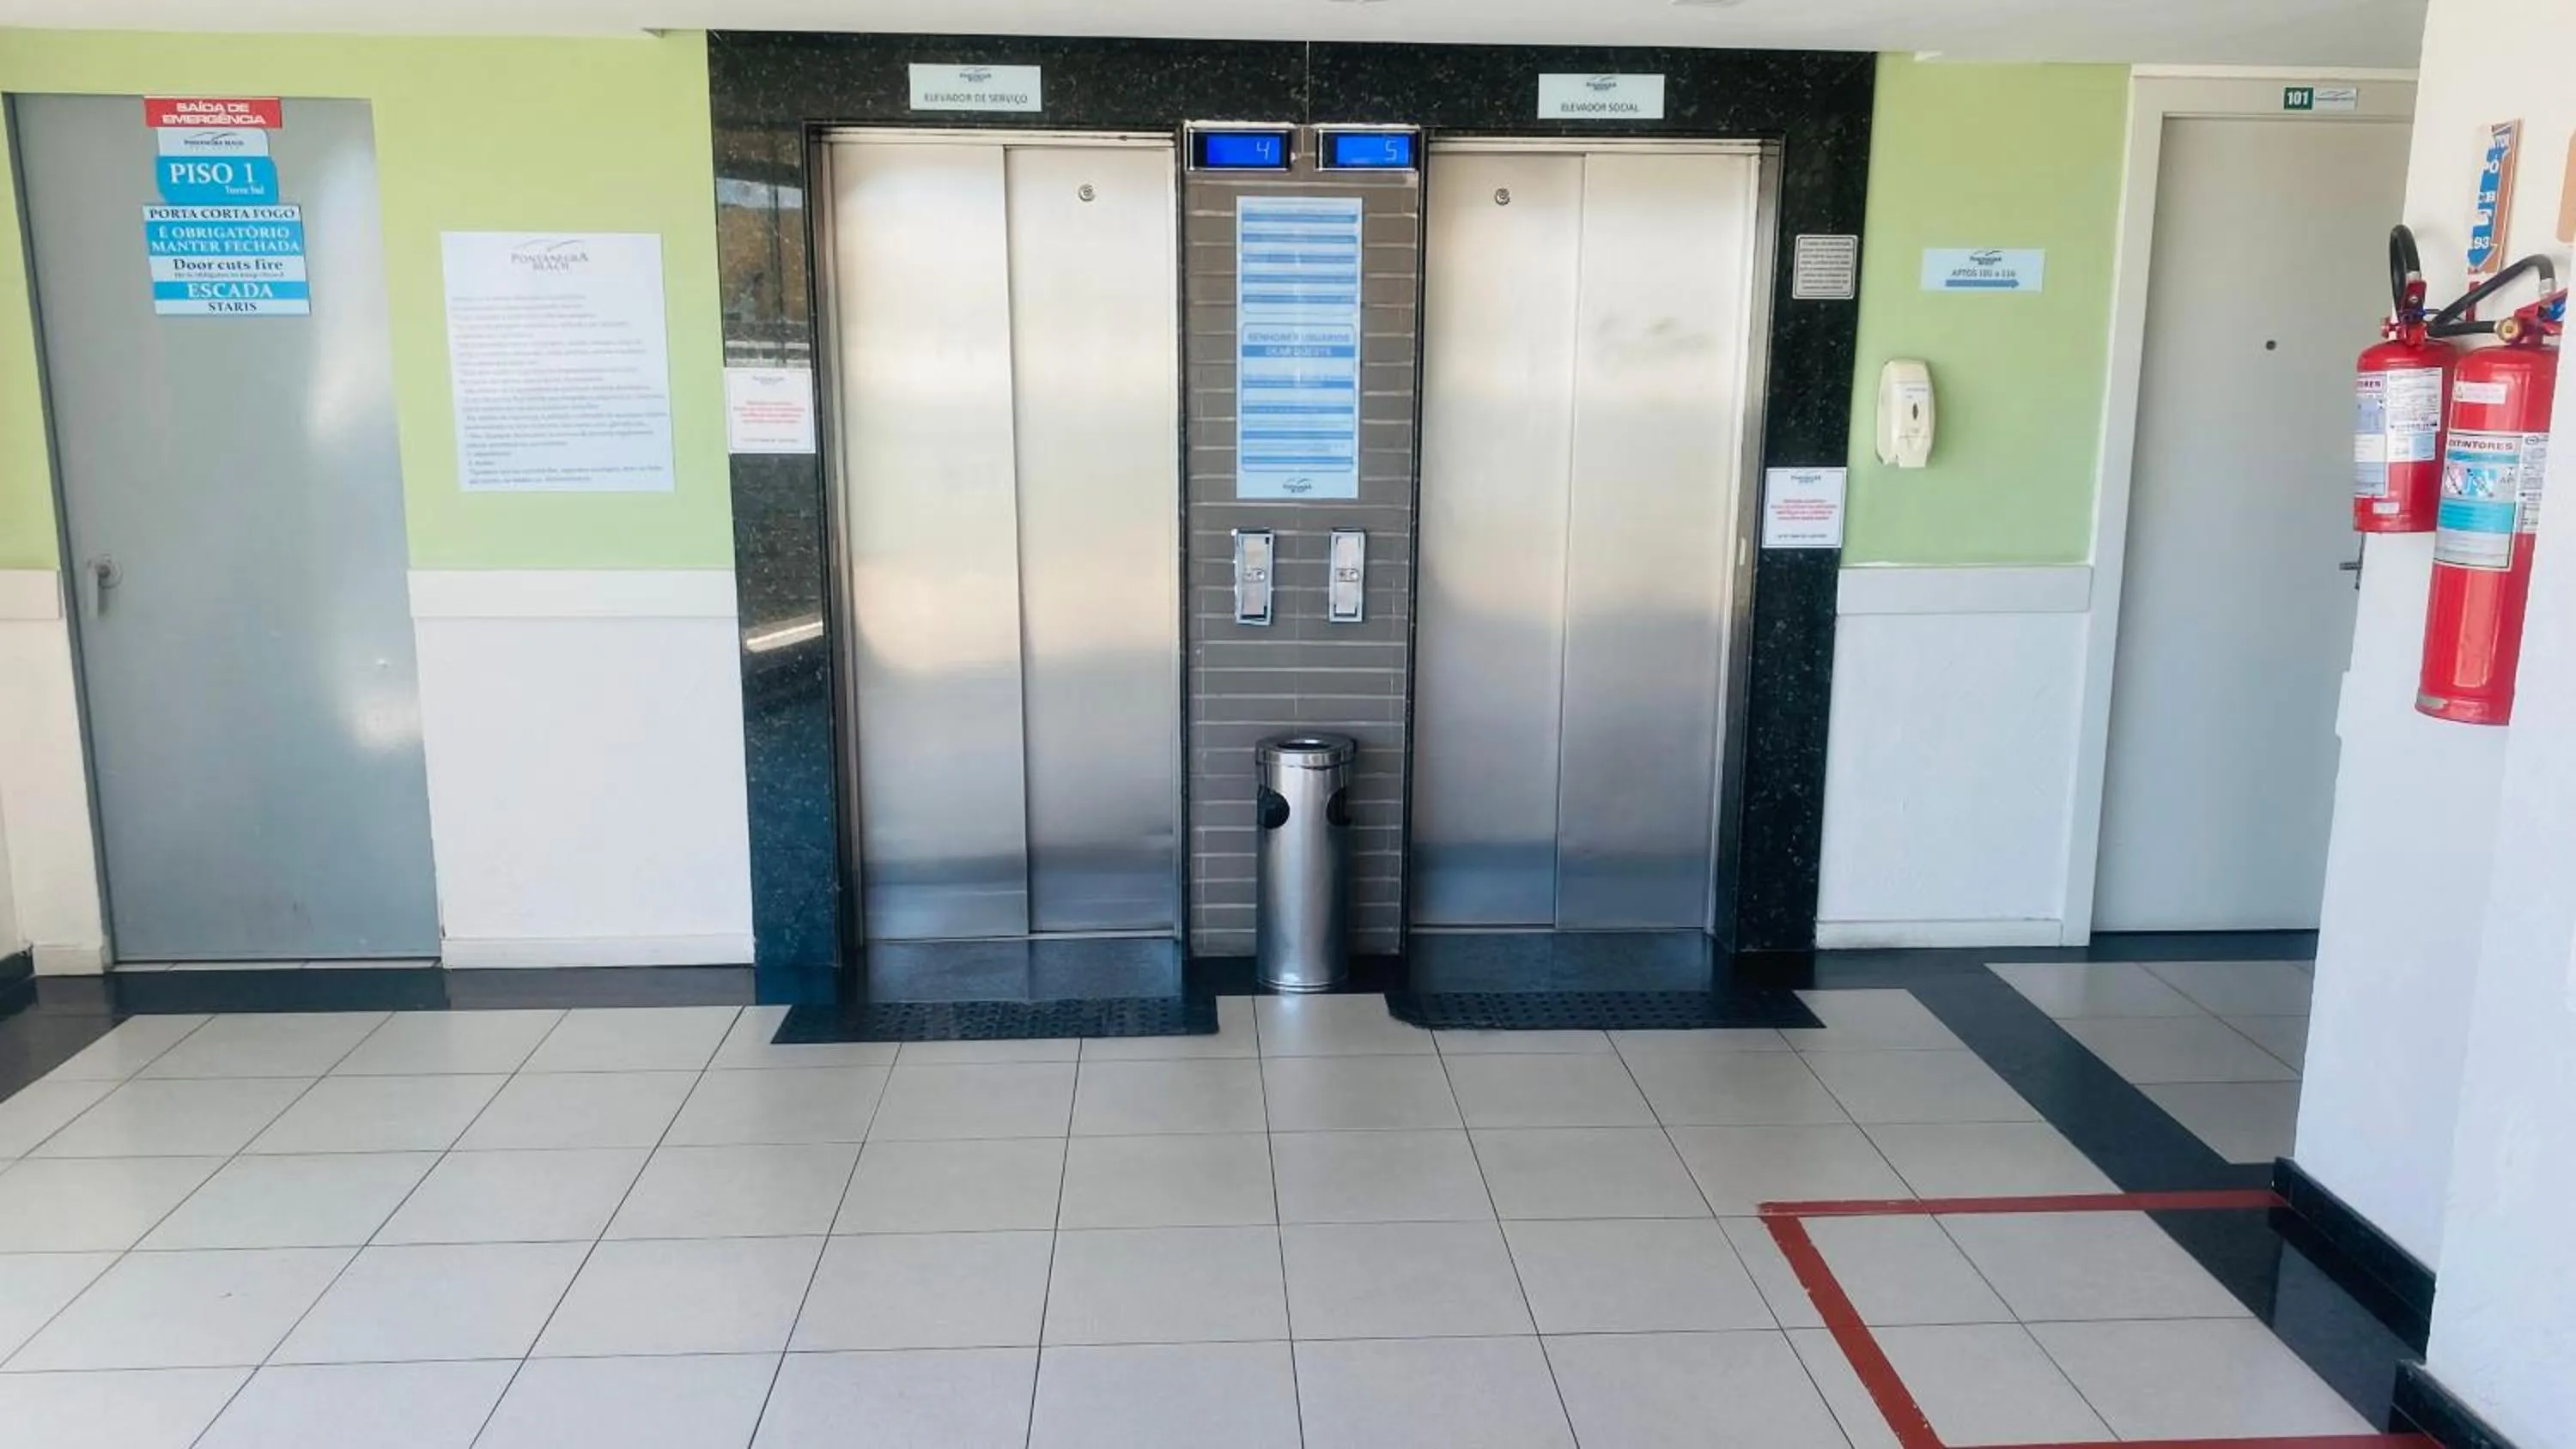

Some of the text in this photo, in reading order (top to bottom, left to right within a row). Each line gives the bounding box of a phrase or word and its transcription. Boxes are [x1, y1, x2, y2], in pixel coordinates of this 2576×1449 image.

[924, 94, 1028, 104] ELEVADOR DE SERVIÇO
[2287, 91, 2308, 106] 101
[176, 100, 249, 112] SAÍDA DE
[1561, 103, 1639, 112] ELEVADOR SOCIAL
[162, 113, 266, 124] EMERGÊNCIA
[1256, 141, 1270, 160] 4
[1385, 140, 1398, 161] 5
[170, 162, 254, 184] PISO 1
[149, 209, 295, 218] PORTA CORTA FOGO
[172, 225, 289, 238] OBRIGATÓRIO
[152, 239, 300, 252] MANTER FECHADA
[173, 258, 283, 270] Door cuts fire
[188, 282, 274, 298] ESCADA
[209, 302, 258, 312] STARIS
